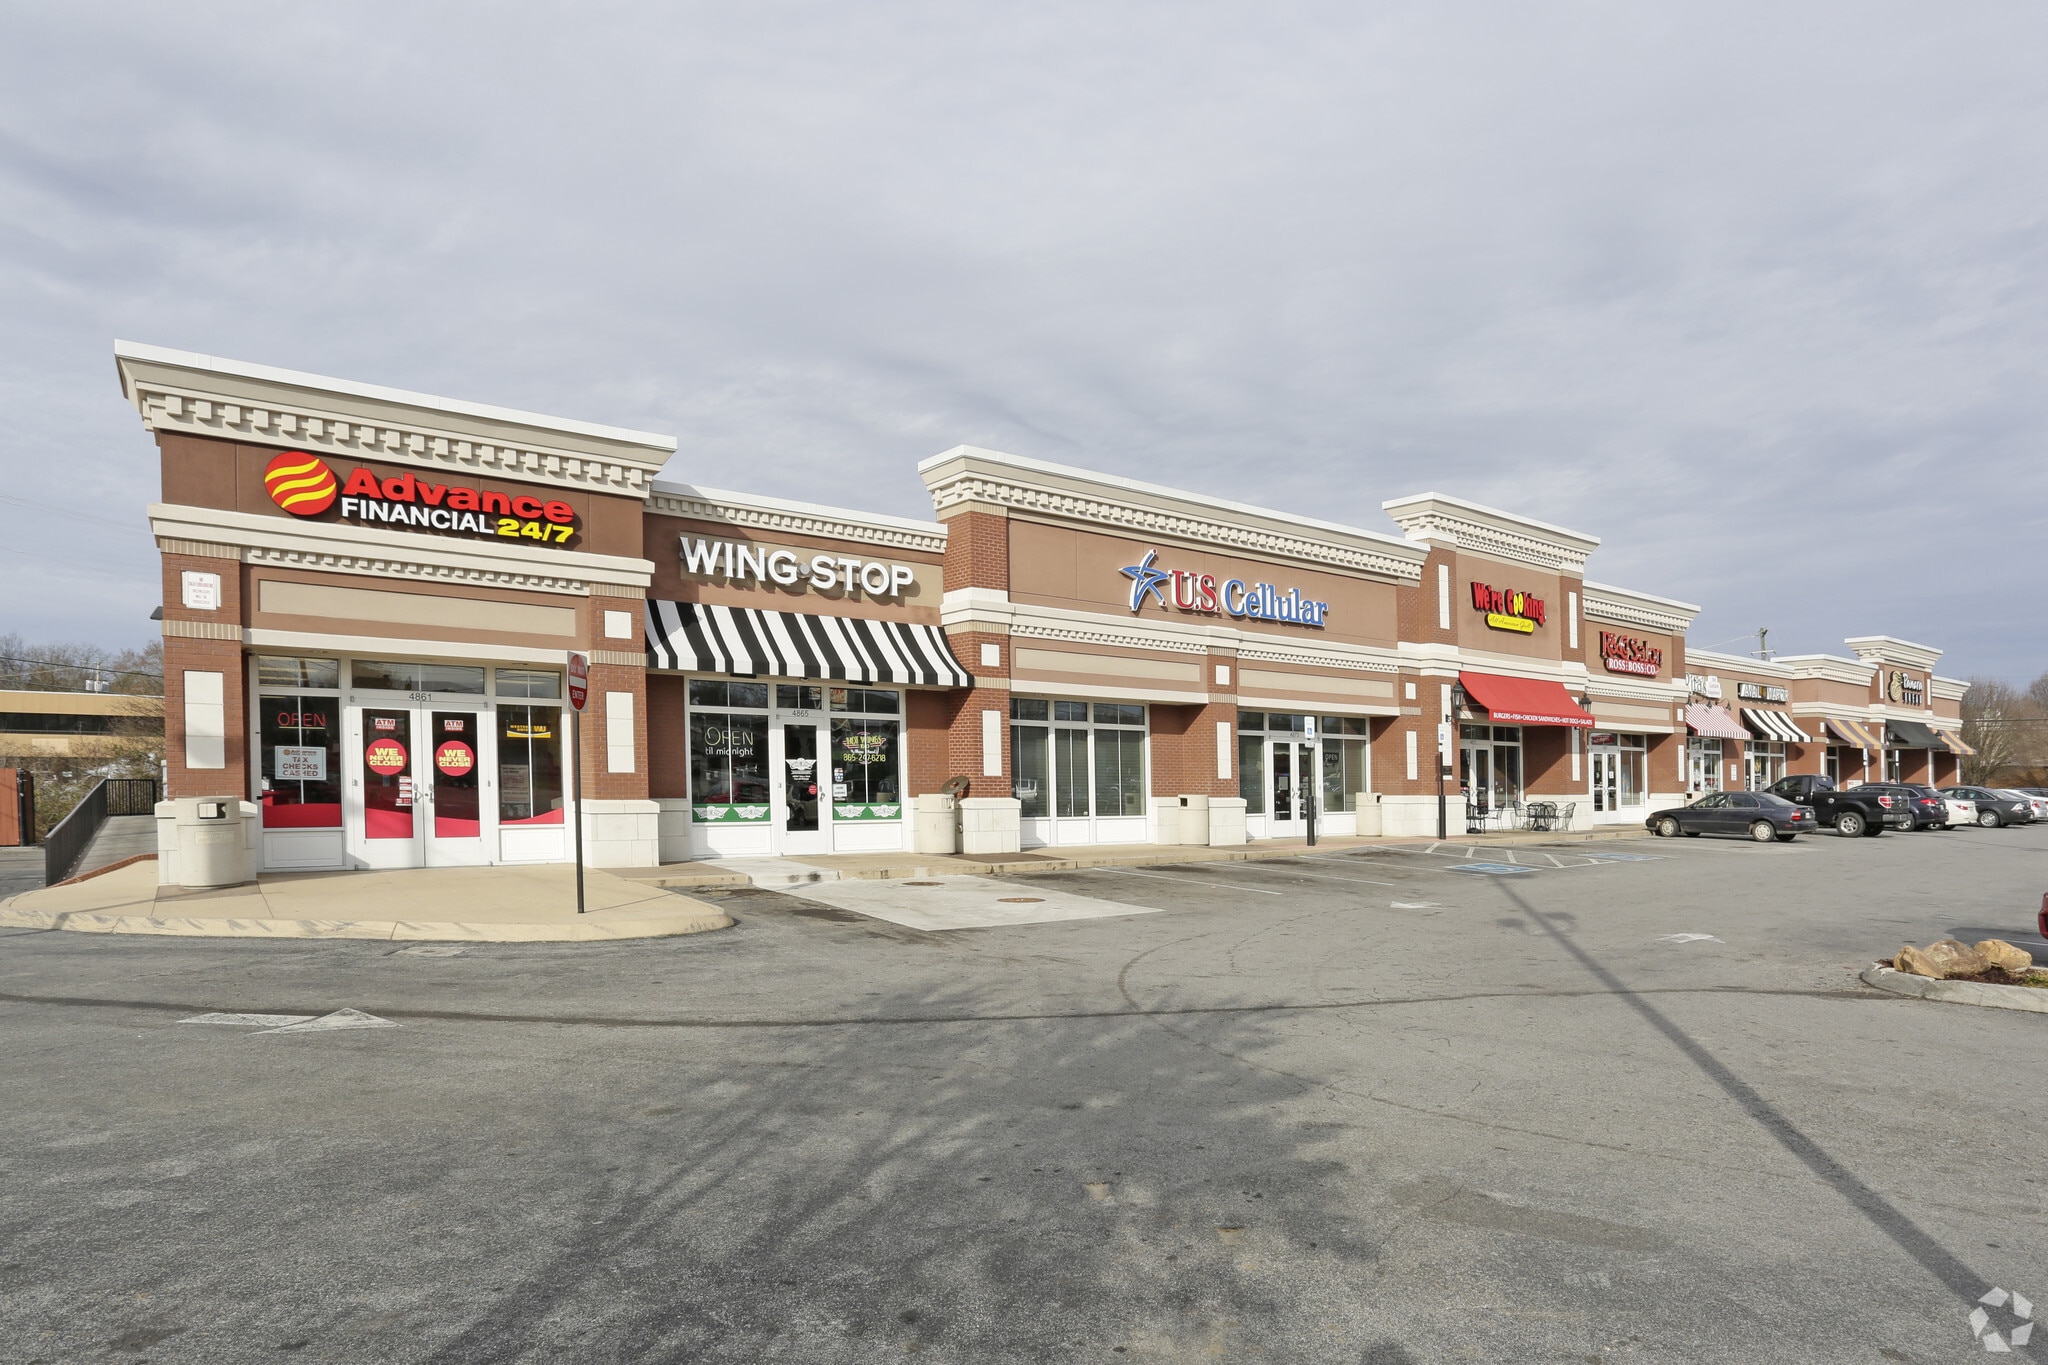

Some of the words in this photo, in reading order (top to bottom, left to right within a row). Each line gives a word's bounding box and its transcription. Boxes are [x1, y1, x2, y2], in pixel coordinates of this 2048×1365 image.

[342, 467, 574, 523] Advance
[341, 497, 494, 535] FINANCIAL
[497, 518, 574, 543] 24/7
[680, 536, 798, 585] WING
[810, 555, 914, 597] STOP
[1168, 569, 1221, 613] U.S.
[1221, 578, 1328, 627] Cellular
[1472, 582, 1504, 613] We're
[1505, 588, 1546, 626] Cooking
[1629, 637, 1663, 665] Salon
[570, 663, 576, 673] DO
[577, 665, 585, 675] NOT
[1608, 658, 1626, 671] ROSS
[1628, 661, 1645, 674] BOSS
[408, 692, 432, 702] 4861
[572, 689, 584, 700] ENTER
[277, 712, 327, 727] OPEN
[792, 710, 809, 718] 4865
[1493, 711, 1511, 720] BURGERS
[1512, 713, 1521, 721] FISH
[1522, 714, 1538, 722] CHICKEN
[1538, 715, 1560, 724] SANDWICHES
[1569, 717, 1579, 725] DOGS
[1580, 718, 1593, 726] SALADS
[705, 726, 754, 746] OPEN
[374, 748, 399, 756] WE
[443, 749, 466, 757] WE
[716, 747, 754, 757] midnight
